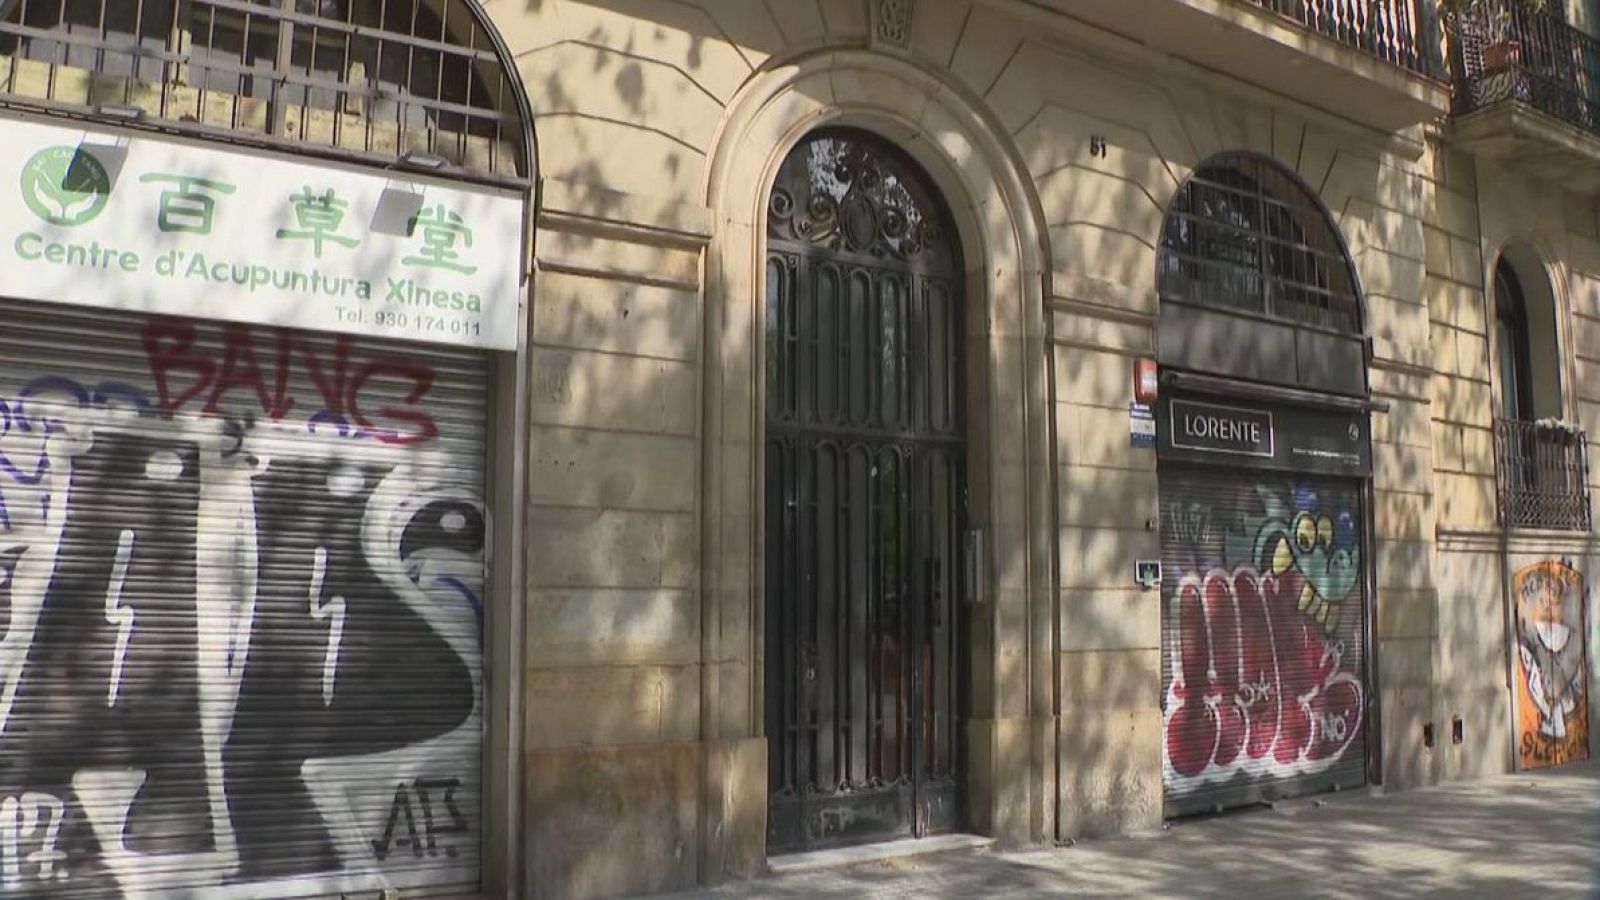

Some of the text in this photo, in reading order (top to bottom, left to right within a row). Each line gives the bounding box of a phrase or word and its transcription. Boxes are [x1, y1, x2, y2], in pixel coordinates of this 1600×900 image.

[139, 171, 478, 275] 百草堂
[14, 231, 481, 313] Centre d'Acupuntura Xinesa
[334, 305, 480, 336] Tel. 930 174 011
[141, 318, 439, 446] BANG
[1184, 413, 1261, 444] LORENTE
